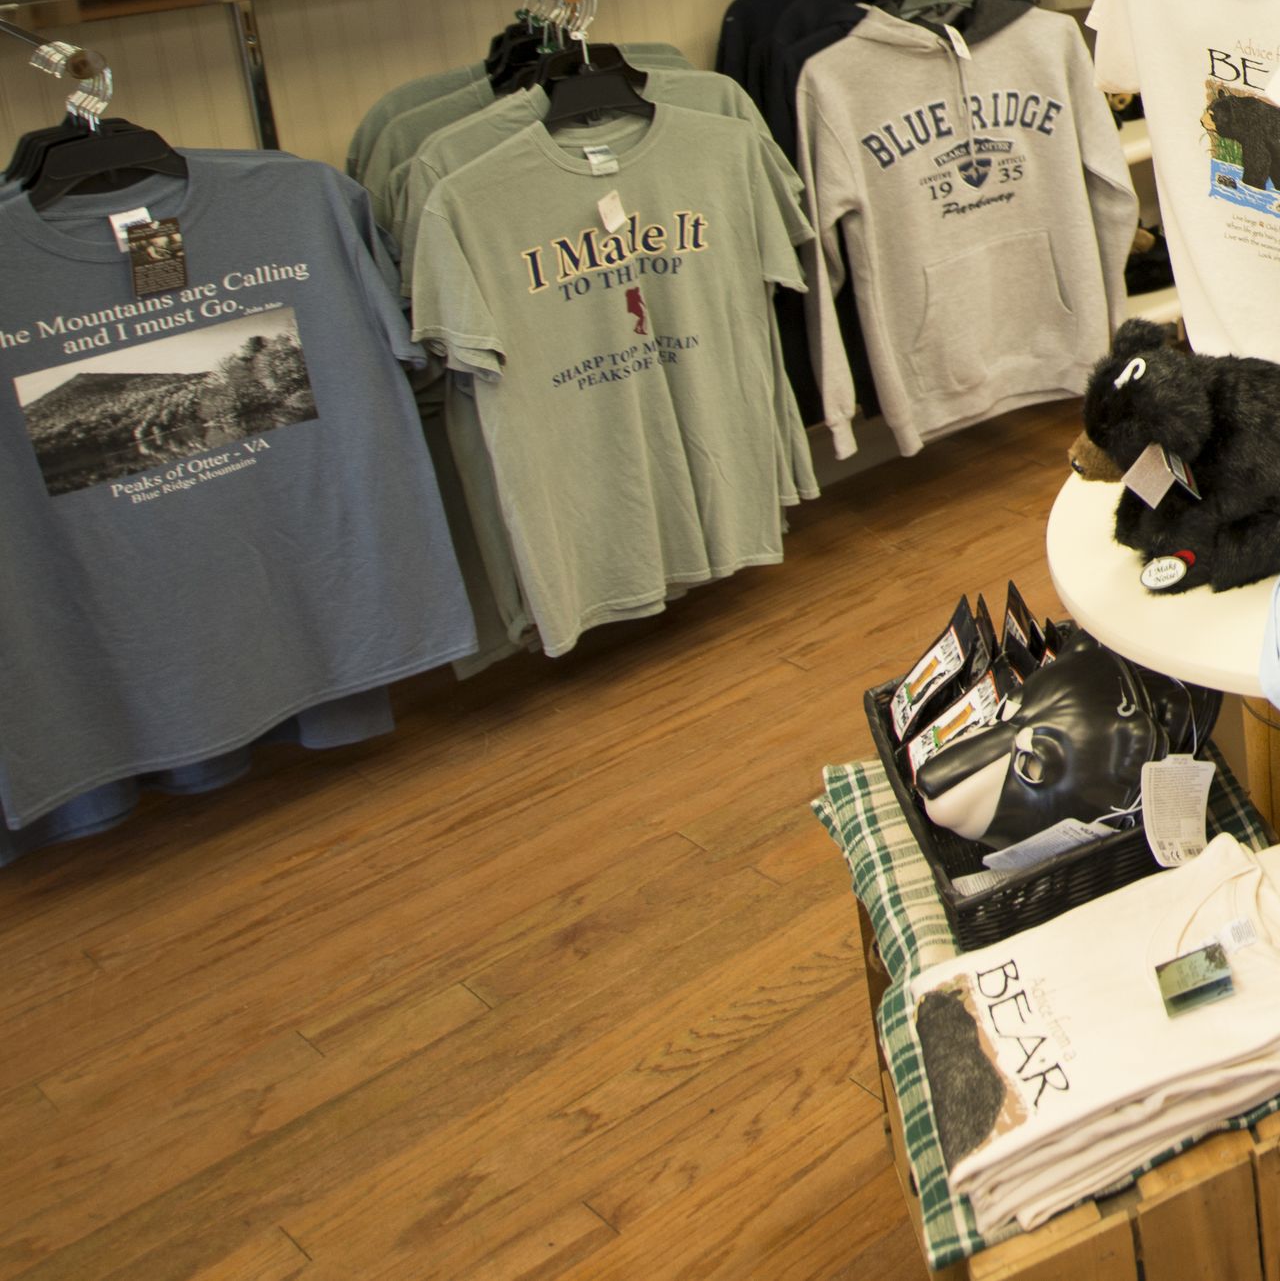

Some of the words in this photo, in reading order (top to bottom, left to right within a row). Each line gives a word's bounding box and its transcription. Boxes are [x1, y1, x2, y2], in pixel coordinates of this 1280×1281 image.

[1207, 48, 1270, 92] BE
[1235, 38, 1273, 62] Advice
[861, 101, 954, 169] BLUE
[963, 91, 1063, 136] RIDGE
[929, 181, 953, 201] 19
[998, 164, 1024, 184] 35
[523, 247, 548, 293] I
[674, 210, 708, 252] It
[0, 327, 31, 349] he
[36, 292, 174, 340] Mountains
[180, 284, 217, 303] are
[223, 263, 309, 291] Calling
[558, 276, 591, 302] TO
[597, 265, 638, 290] TH
[635, 256, 682, 275] TOP
[63, 327, 111, 356] and
[116, 323, 129, 342] I
[134, 308, 195, 336] must
[200, 299, 245, 320] Go.
[551, 355, 605, 388] SHARP
[607, 345, 639, 366] TOP
[641, 334, 699, 355] MNTAIN
[576, 367, 632, 390] PEAKS
[632, 354, 654, 375] OF
[110, 475, 163, 498] Peaks
[166, 463, 186, 481] of
[187, 452, 231, 474] Otter
[243, 438, 271, 454] VA
[130, 489, 161, 504] Blue
[161, 478, 198, 495] Ridge
[199, 457, 258, 483] Mountains
[976, 958, 1070, 1108] BEAR
